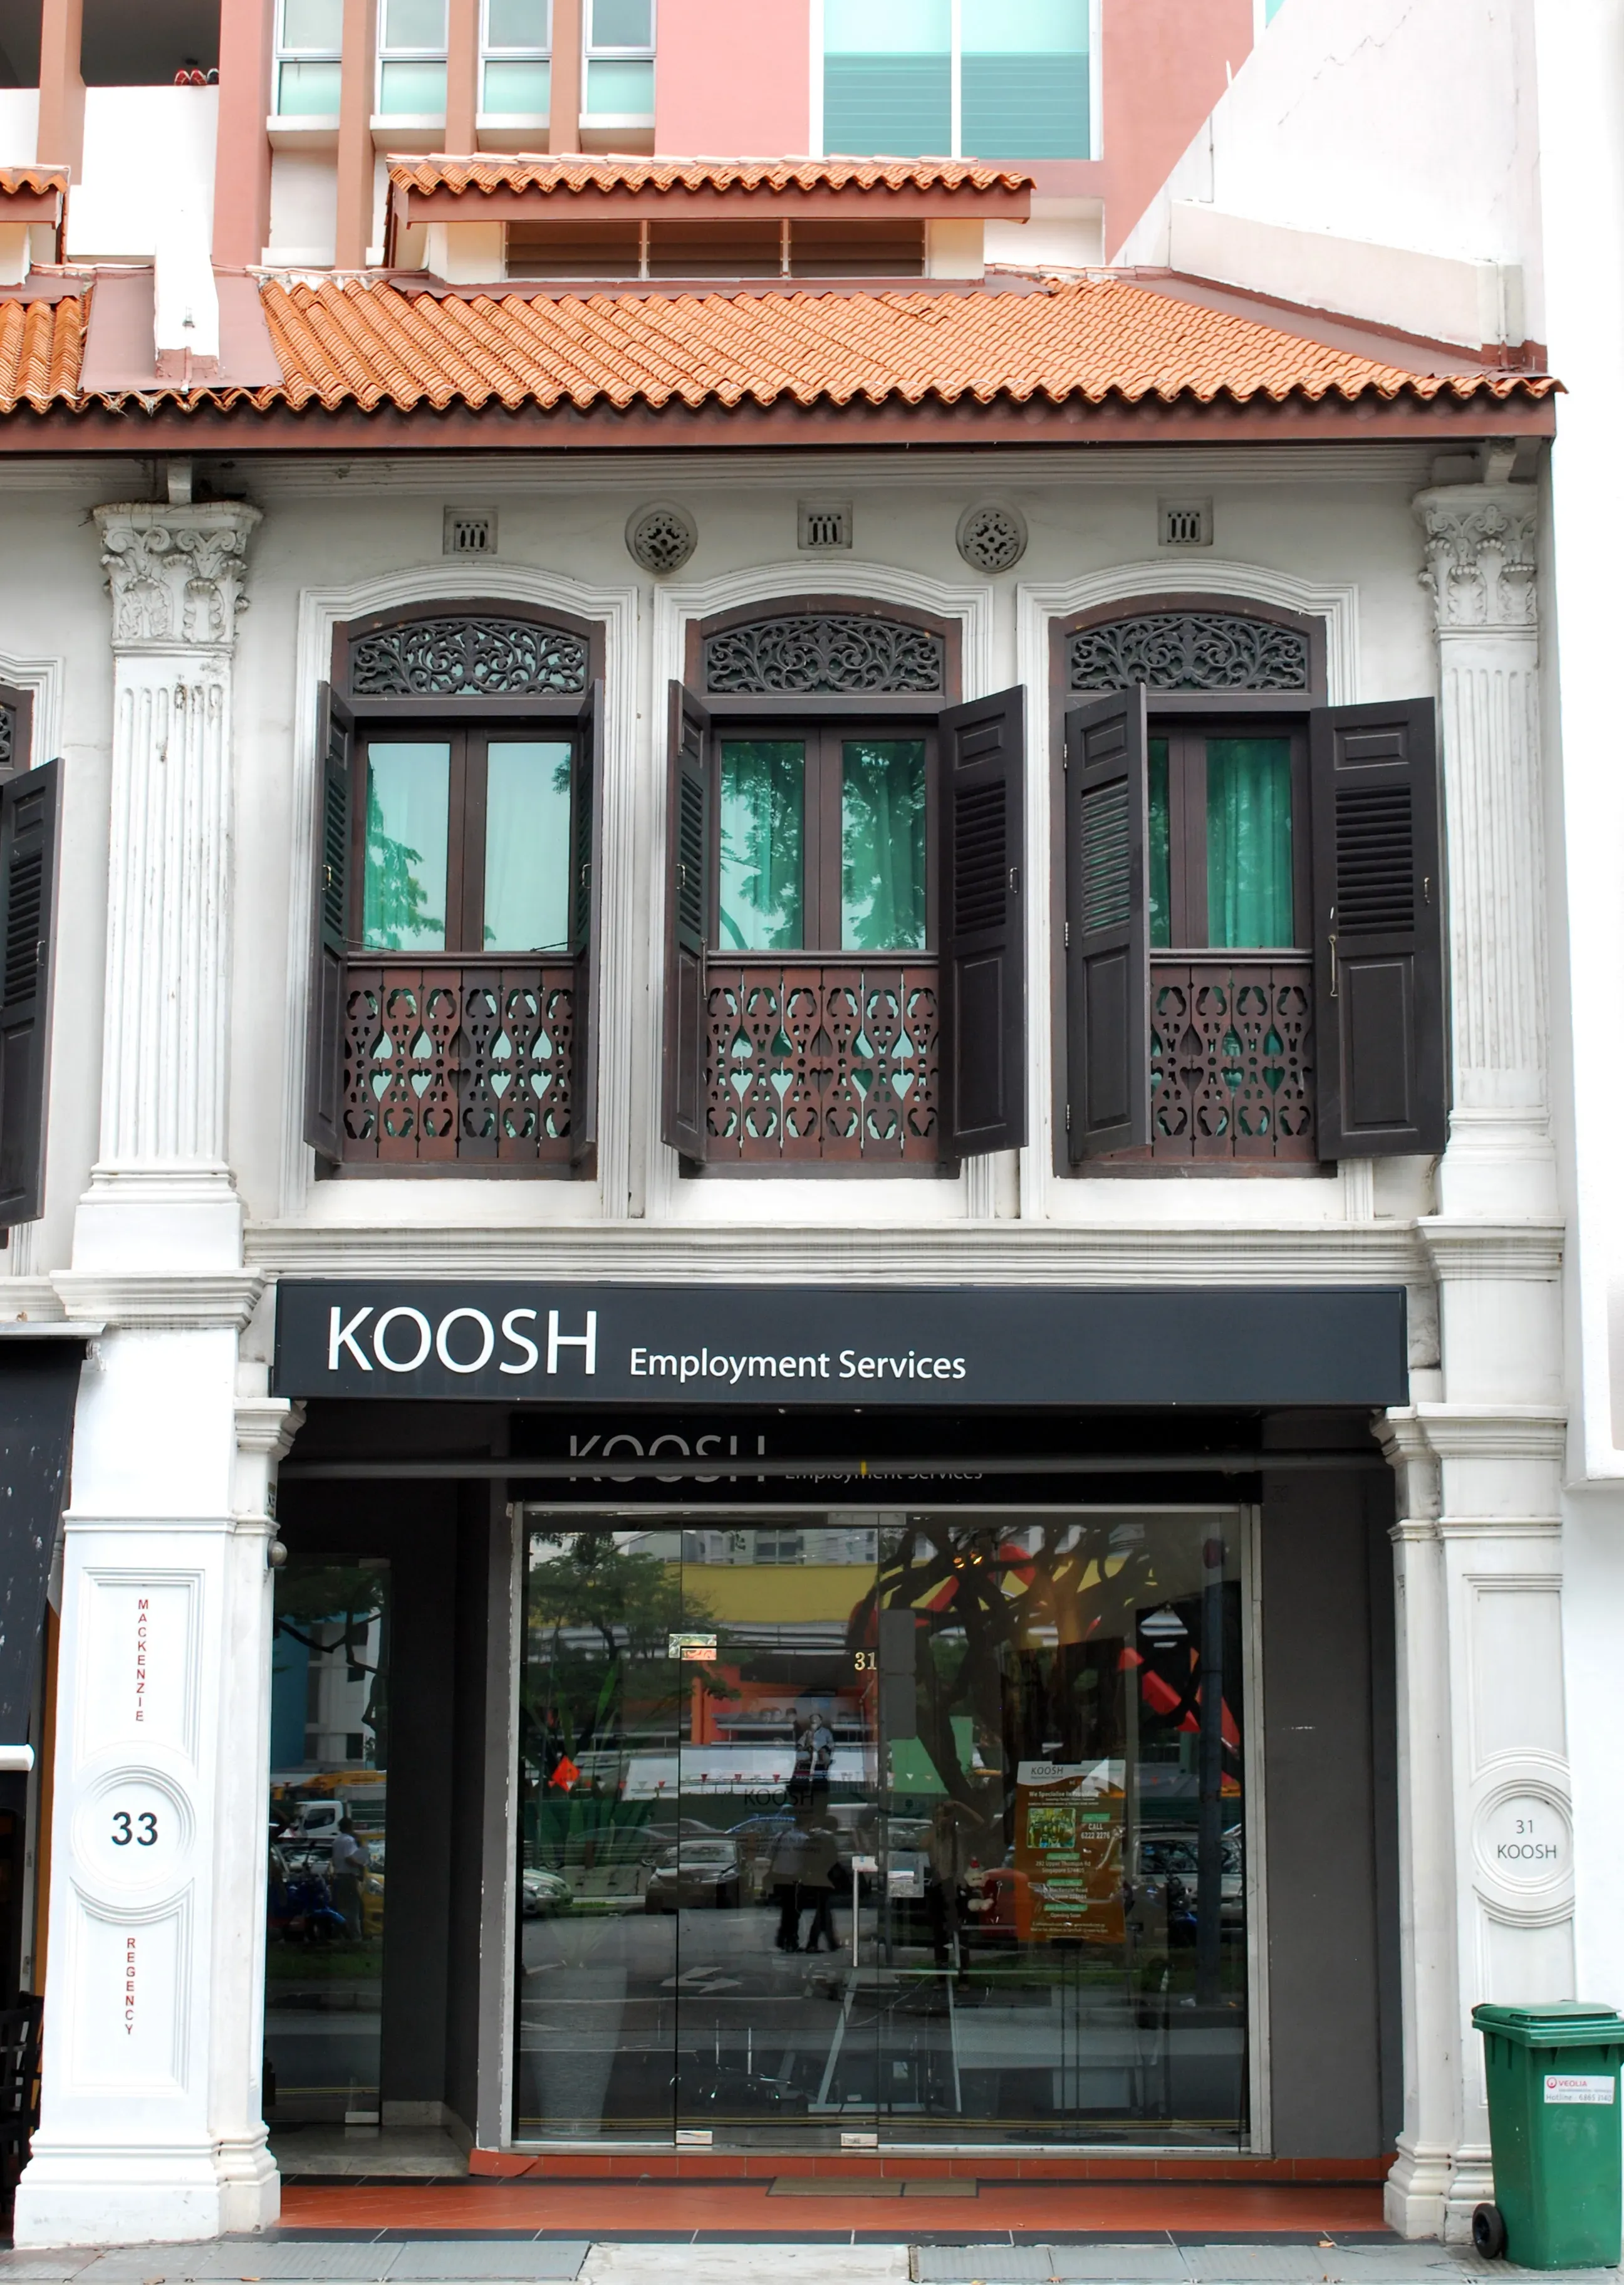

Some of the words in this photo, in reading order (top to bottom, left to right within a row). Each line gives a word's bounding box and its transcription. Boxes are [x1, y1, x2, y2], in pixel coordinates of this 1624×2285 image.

[328, 1307, 598, 1375] KOOSH
[630, 1348, 831, 1384] Employment
[840, 1350, 967, 1379] Services
[136, 1599, 149, 1722] MACKENZIE
[855, 1652, 877, 1671] 31
[1031, 1766, 1064, 1775] KOOSH
[744, 1789, 814, 1806] KOOSH
[112, 1812, 158, 1846] 33
[1516, 1819, 1533, 1834] 31
[1497, 1844, 1557, 1859] KOOSH
[125, 1937, 136, 2035] REGENCY
